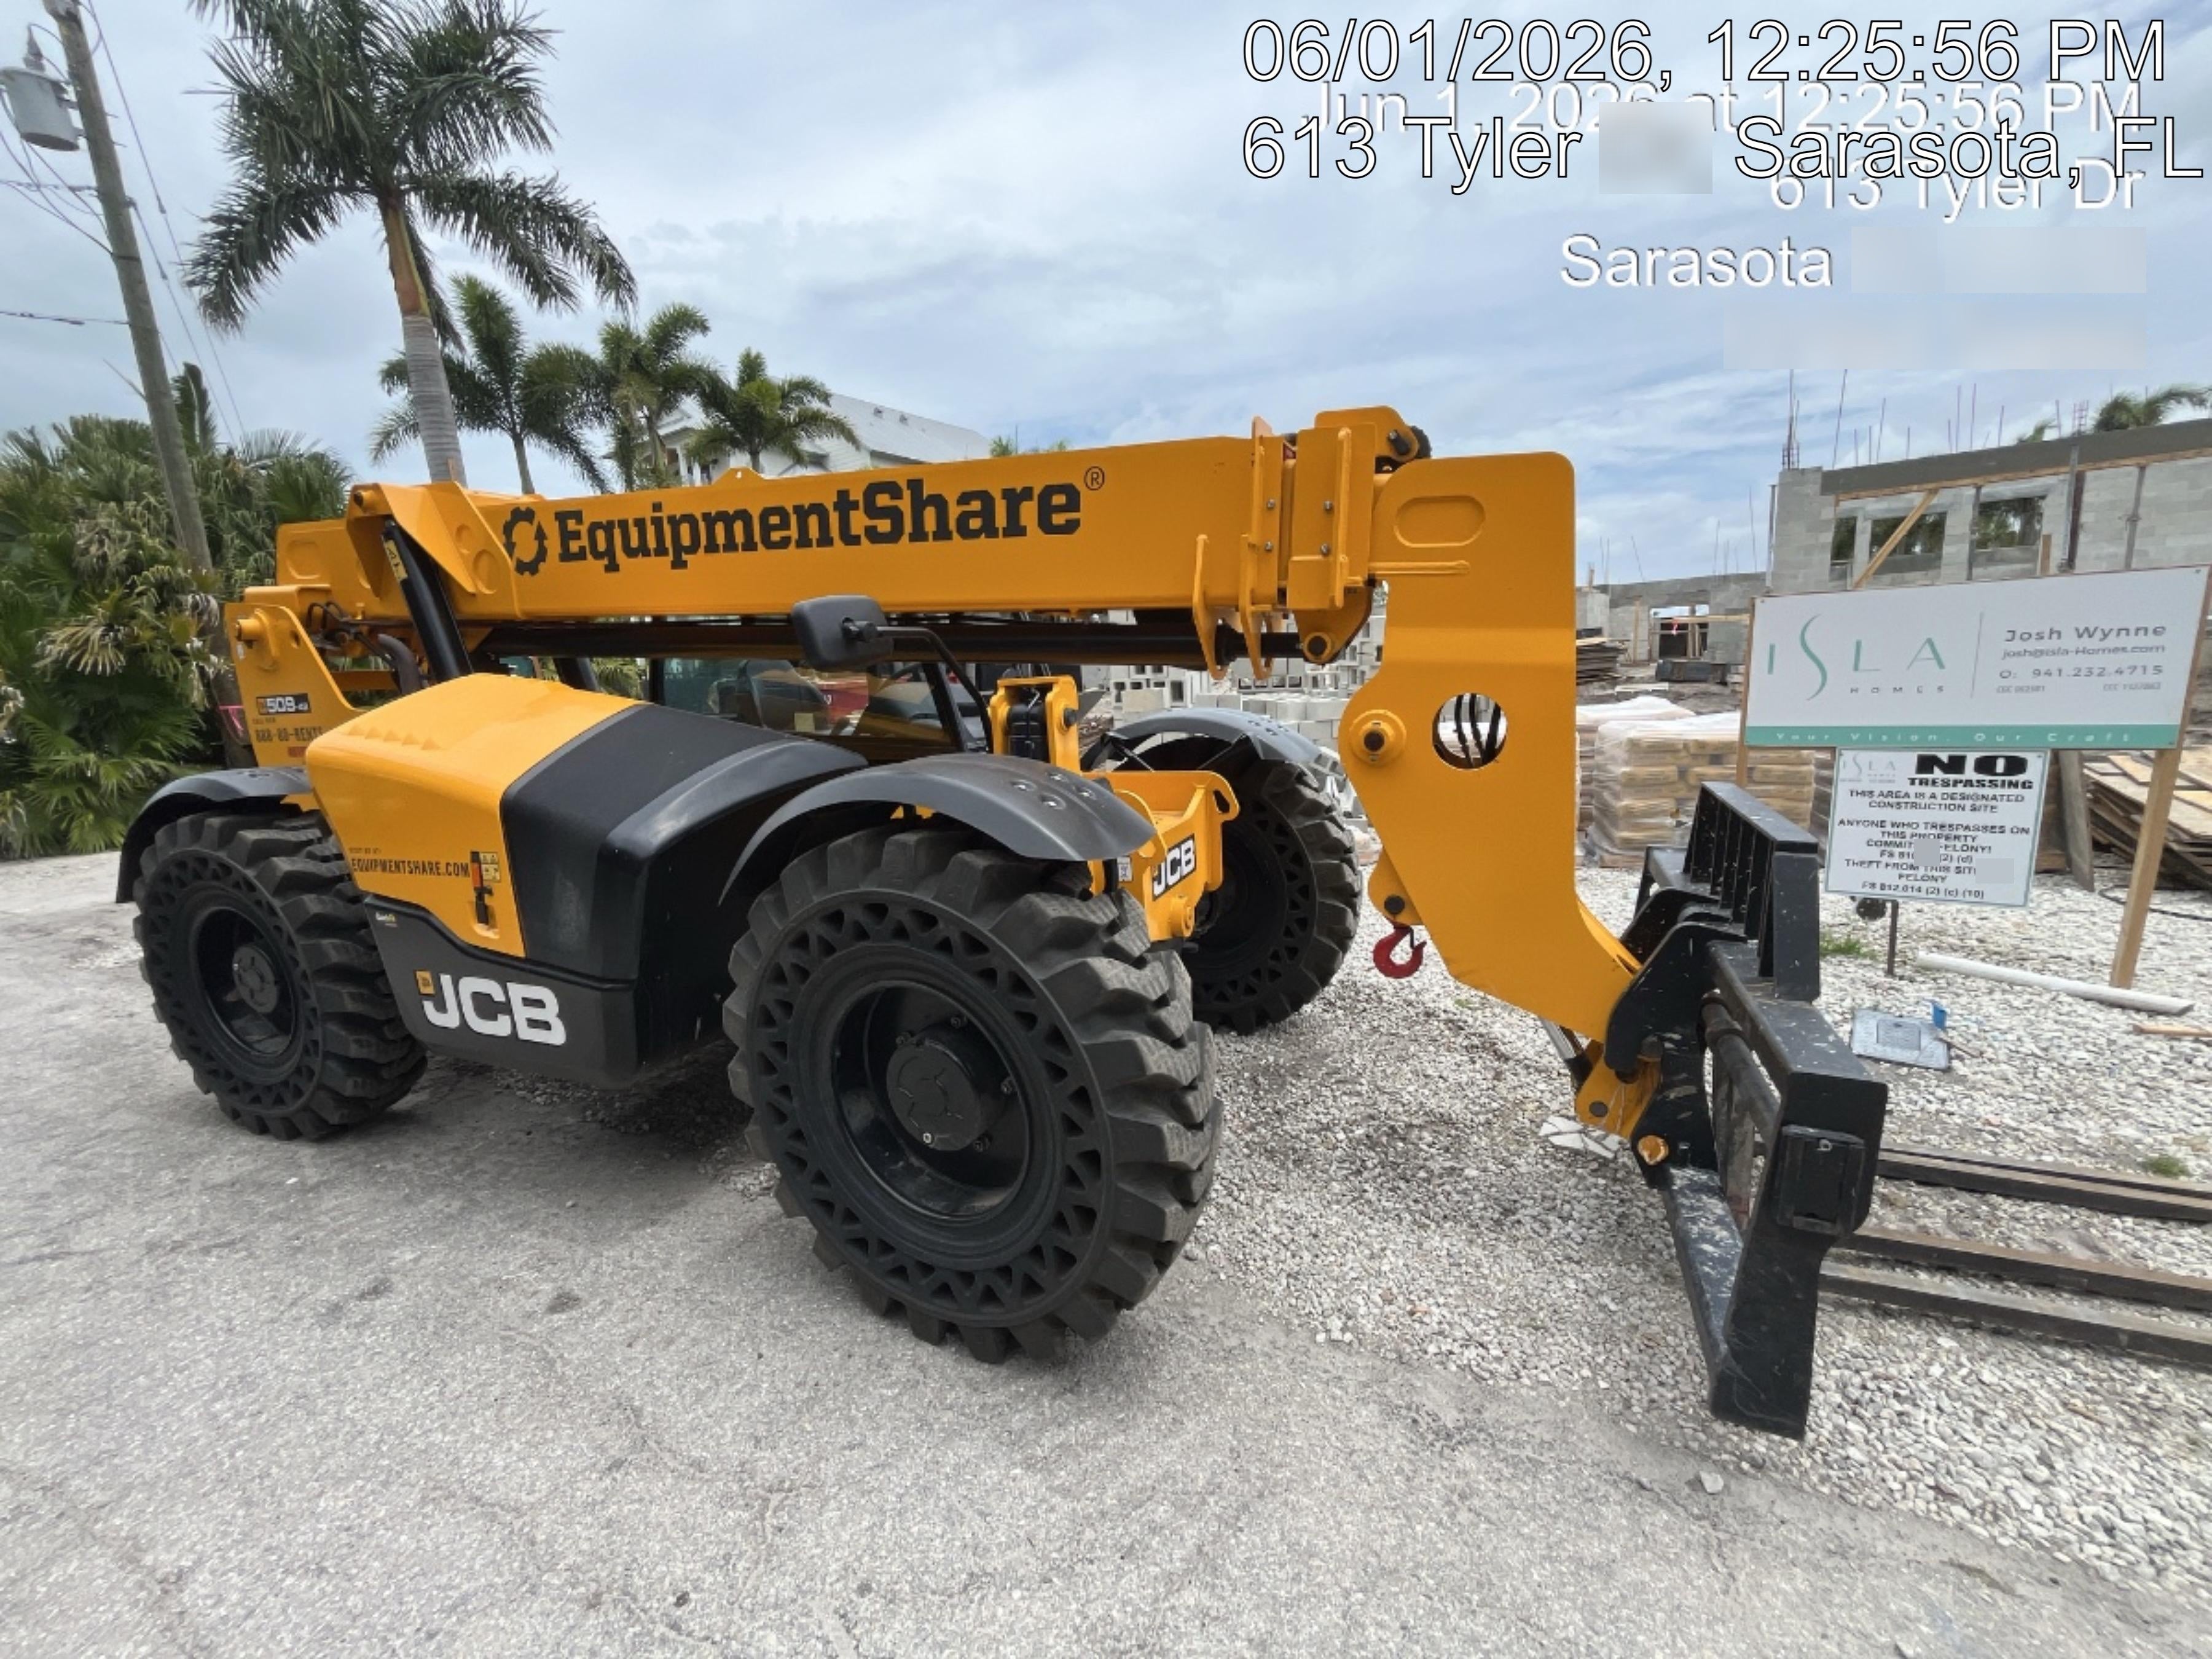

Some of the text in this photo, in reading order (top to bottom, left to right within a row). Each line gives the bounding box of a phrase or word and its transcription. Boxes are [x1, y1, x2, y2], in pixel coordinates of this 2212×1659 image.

[2005, 626, 2167, 642] Josh Wynne
[1768, 614, 1945, 700] ISLA
[1850, 685, 1943, 694] HOMES
[1974, 733, 2021, 742] Our
[2047, 732, 2128, 742] Craft
[1915, 753, 2028, 776] NO
[1907, 777, 2033, 789] TRESPASSING
[1877, 791, 1910, 799] AREA
[1940, 793, 2025, 802] DESIGNATED
[1869, 801, 1998, 813] CONSTRUCTION SITE
[1837, 818, 2030, 834] ANYONE WHO TRESPASSES ON
[1910, 832, 1979, 843] PROPERTY
[1939, 844, 1991, 853] ELONY!
[351, 858, 470, 877] EQUIPMENTSHARE.COM
[1153, 839, 1196, 897] JCB
[1845, 859, 1880, 869] THEFT
[1885, 861, 1919, 871] FROM
[1898, 874, 1947, 883] FELONY
[1926, 886, 1940, 896] (2)
[422, 973, 566, 1046] JCB
